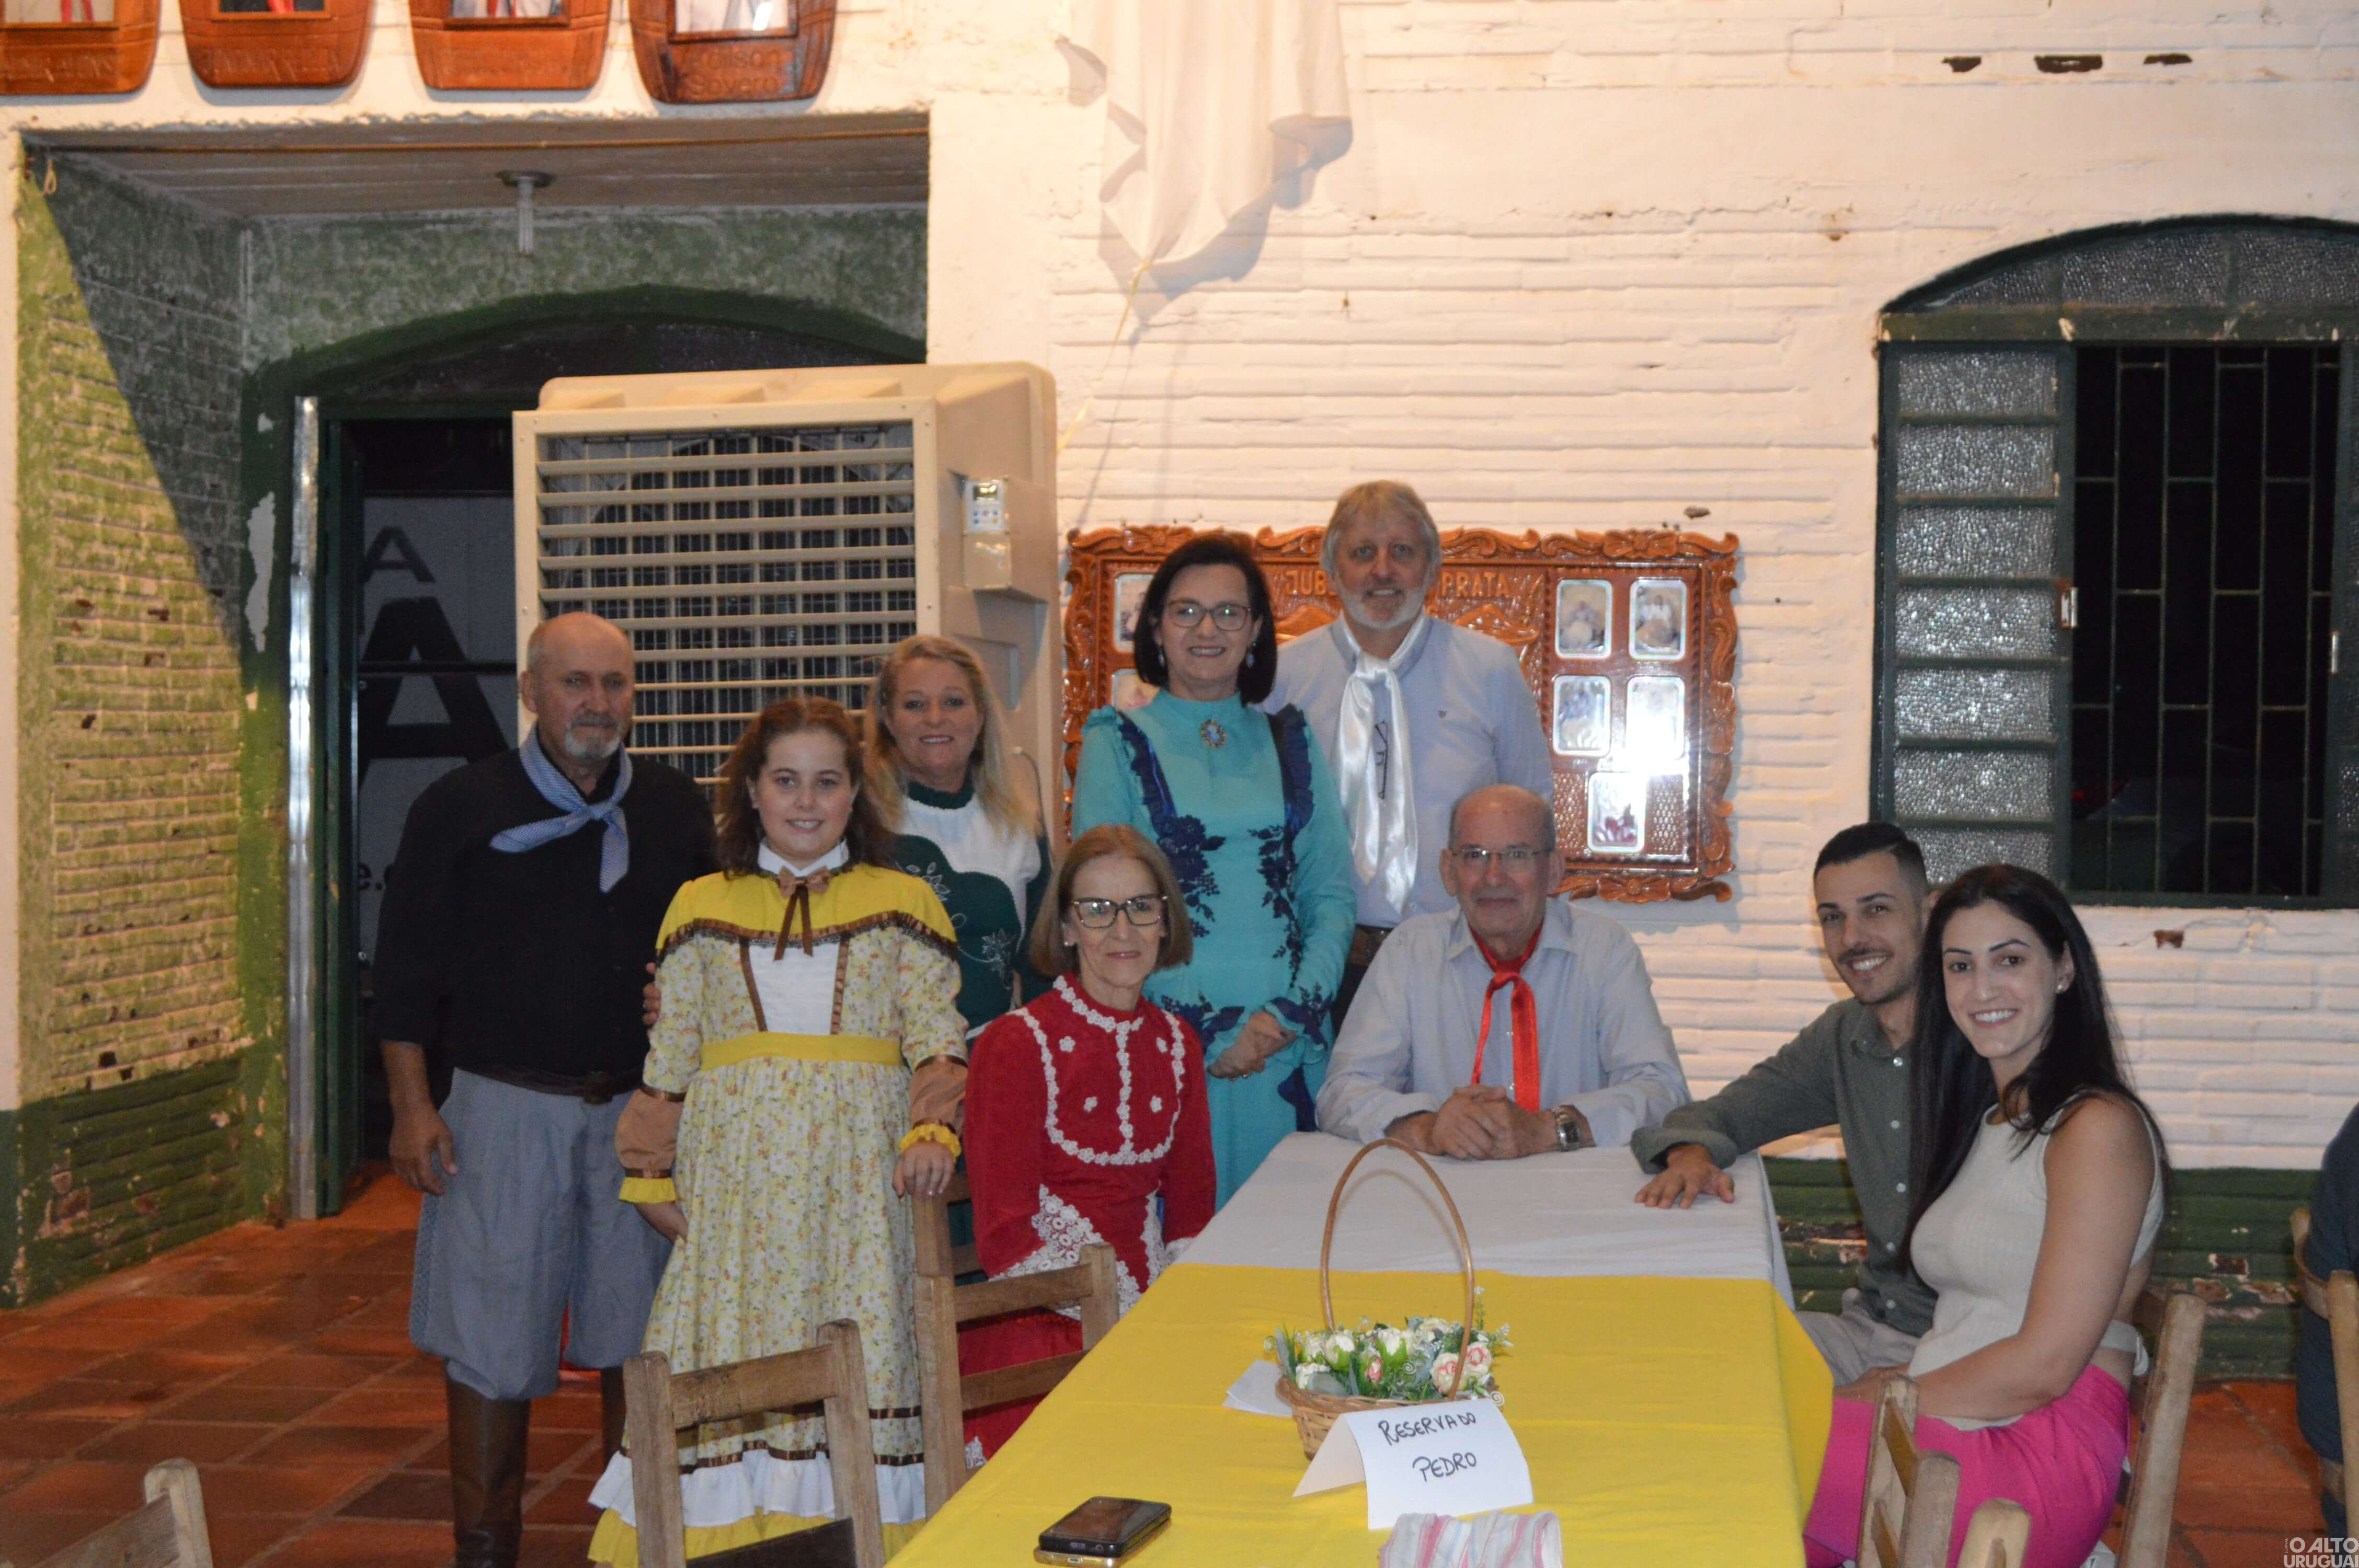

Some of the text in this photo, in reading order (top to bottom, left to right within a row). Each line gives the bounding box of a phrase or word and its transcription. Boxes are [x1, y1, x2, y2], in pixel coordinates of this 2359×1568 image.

[1441, 572, 1509, 596] PRATA
[1378, 1412, 1476, 1446] RESERVADO
[1412, 1451, 1477, 1482] PEDRO
